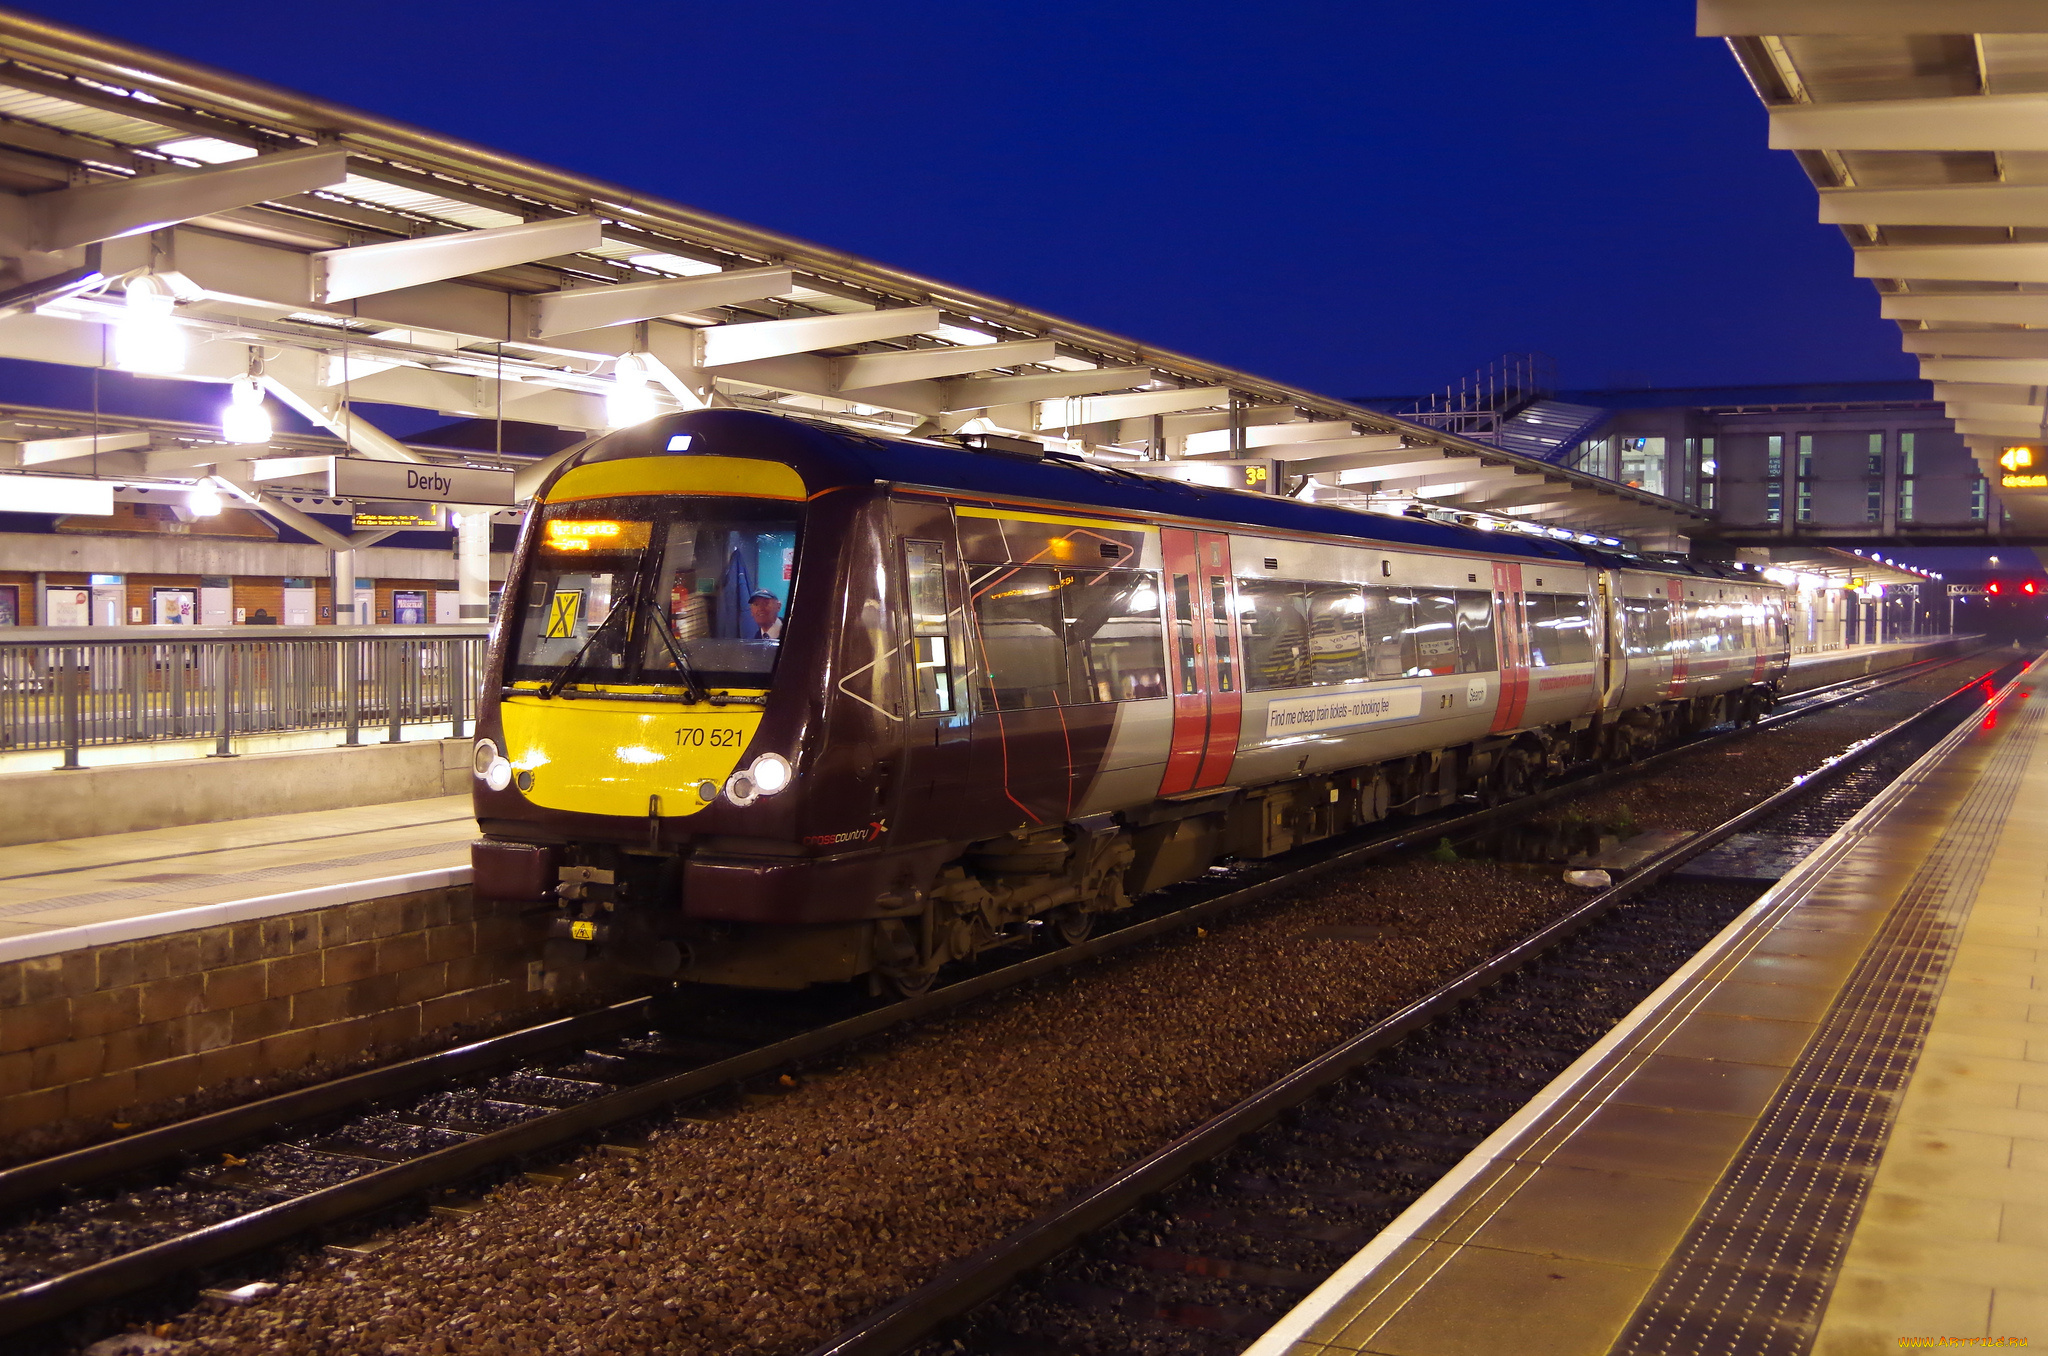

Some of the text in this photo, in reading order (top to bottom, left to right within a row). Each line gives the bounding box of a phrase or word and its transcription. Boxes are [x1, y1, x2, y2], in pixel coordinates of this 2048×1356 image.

[2001, 447, 2032, 471] 4a
[407, 469, 451, 496] Derby
[1246, 468, 1266, 485] 3a
[431, 504, 437, 516] 1
[553, 521, 571, 535] Not
[1469, 688, 1484, 702] Search
[1271, 709, 1285, 726] Find
[1286, 710, 1296, 725] me
[1297, 707, 1315, 725] cheap
[1316, 705, 1329, 721] train
[1330, 703, 1347, 719] tickets
[1352, 704, 1360, 716] no
[1361, 700, 1381, 717] booking
[1381, 698, 1389, 712] fee
[675, 728, 742, 747] 170 521
[803, 829, 869, 845] crosscountry
